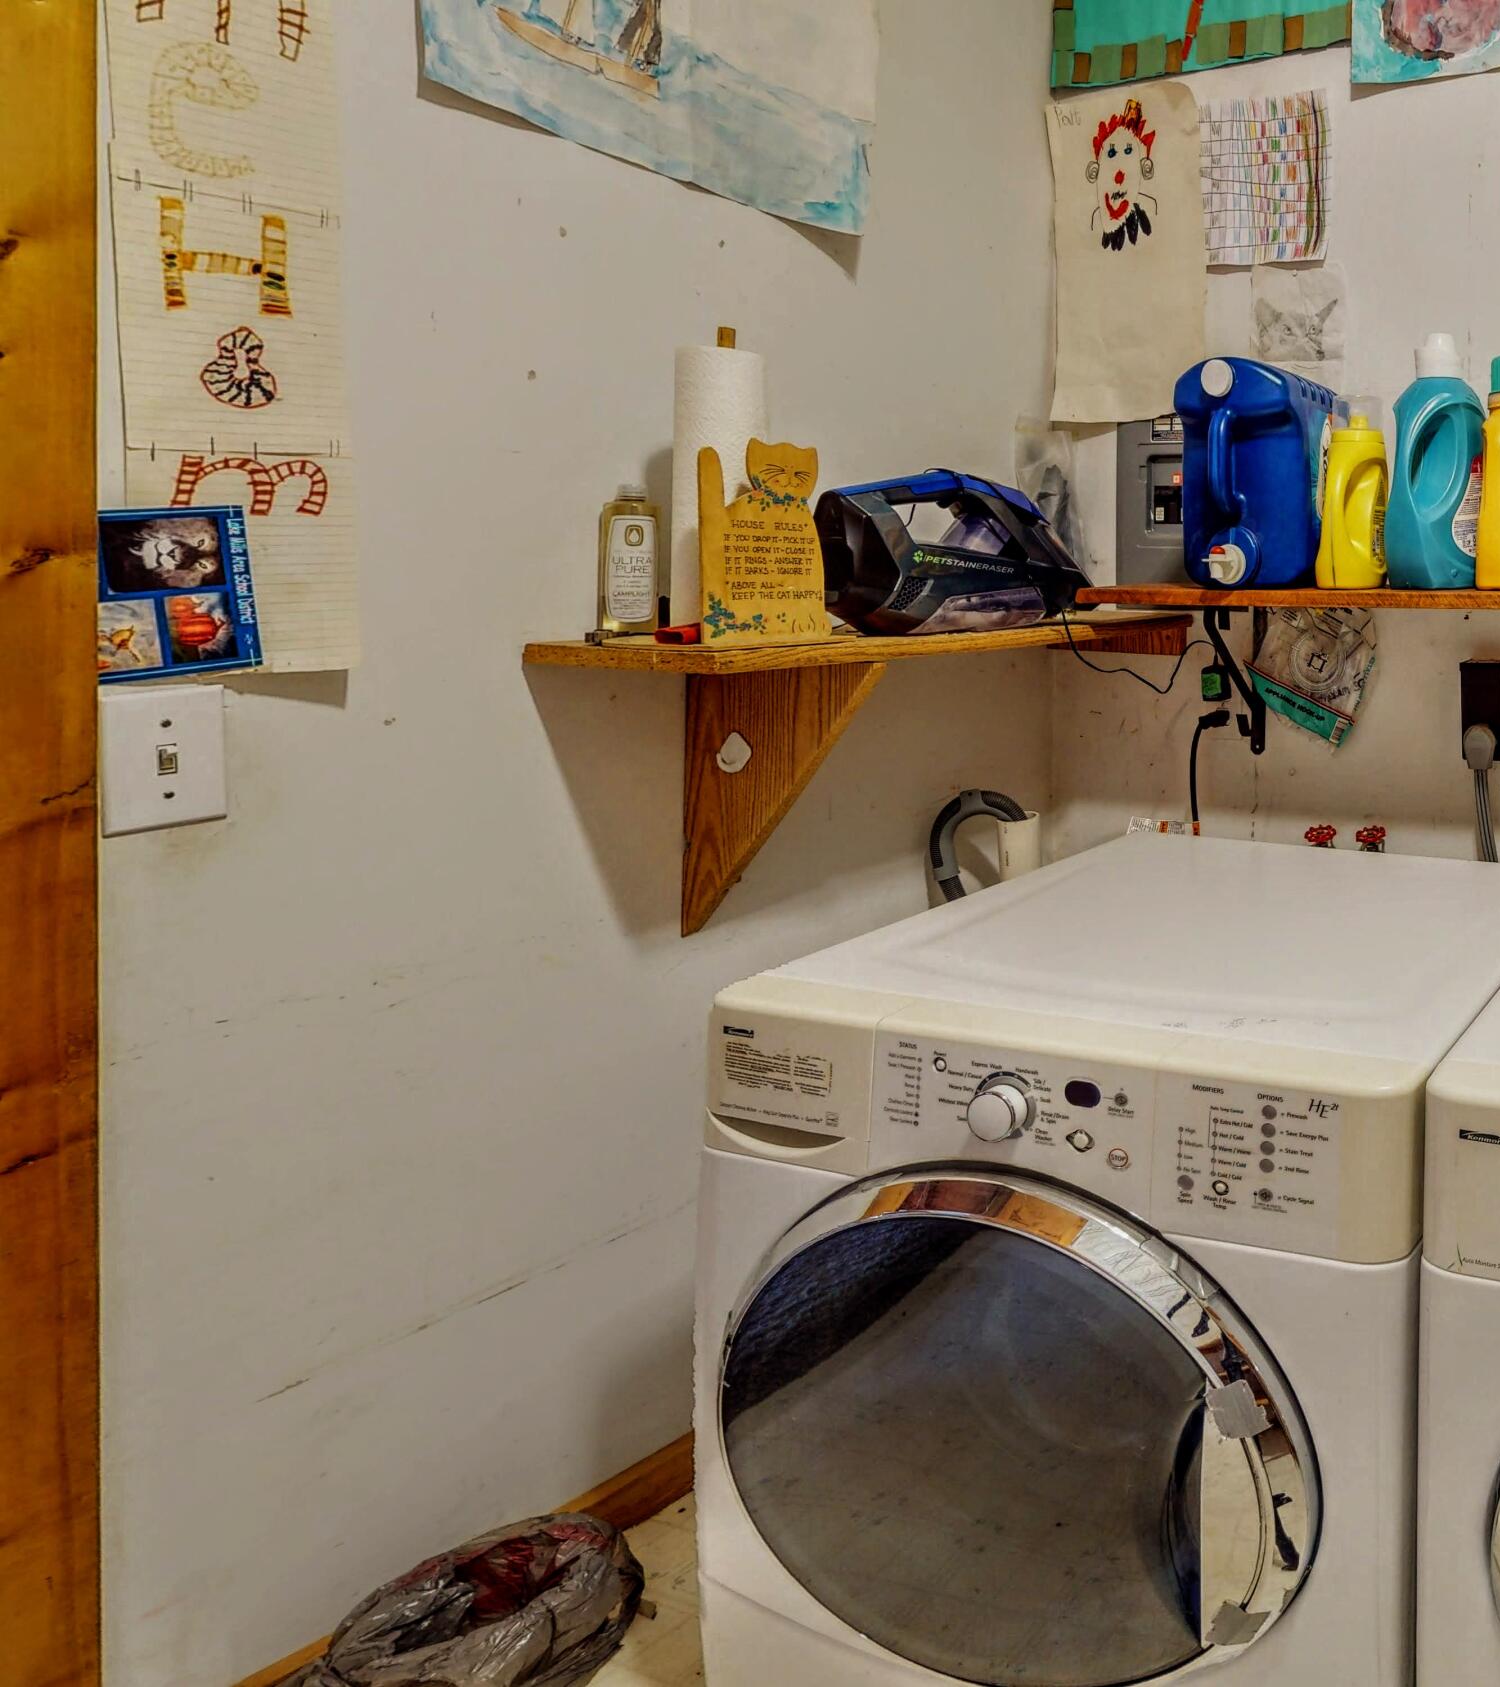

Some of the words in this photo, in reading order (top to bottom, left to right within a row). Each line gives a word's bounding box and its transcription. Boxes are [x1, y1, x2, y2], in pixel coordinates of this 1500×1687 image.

[226, 518, 244, 535] Lake
[731, 519, 765, 530] HOUSE
[723, 533, 732, 542] IF
[733, 534, 750, 542] YOU
[752, 535, 770, 543] DROP
[229, 537, 247, 554] Mills
[724, 545, 732, 553] IF
[733, 545, 750, 554] YOU
[752, 546, 771, 554] OPEN
[808, 547, 815, 555] IT
[232, 556, 248, 573] Area
[611, 555, 653, 565] ULTRA
[725, 556, 732, 565] IF
[734, 556, 741, 565] IT
[744, 556, 767, 565] RINGS
[774, 557, 803, 566] ANSWER
[805, 558, 813, 566] IT
[615, 565, 649, 574] PURE
[725, 567, 733, 575] IF
[734, 567, 742, 575] IT
[744, 567, 769, 575] BARKS
[777, 567, 803, 576] IGNORE
[805, 568, 812, 576] IT
[234, 574, 253, 597] School
[731, 591, 755, 600] KEEP
[758, 591, 775, 600] THE
[776, 591, 791, 600] CAT
[236, 597, 256, 624] District
[1263, 686, 1297, 709] APPLIANCE
[1297, 703, 1326, 721] HOOK-UP
[899, 1041, 918, 1050] STATUS
[971, 1061, 988, 1069] Express
[947, 1069, 964, 1077] Normal
[1192, 1084, 1225, 1095] MODIFIERS
[1257, 1092, 1284, 1103] OPTIONS
[1299, 1132, 1317, 1142] Energy
[1110, 1153, 1127, 1162] STOP
[1283, 1195, 1297, 1203] Cycle
[1298, 1197, 1315, 1206] Signal
[1462, 1256, 1474, 1264] Auto
